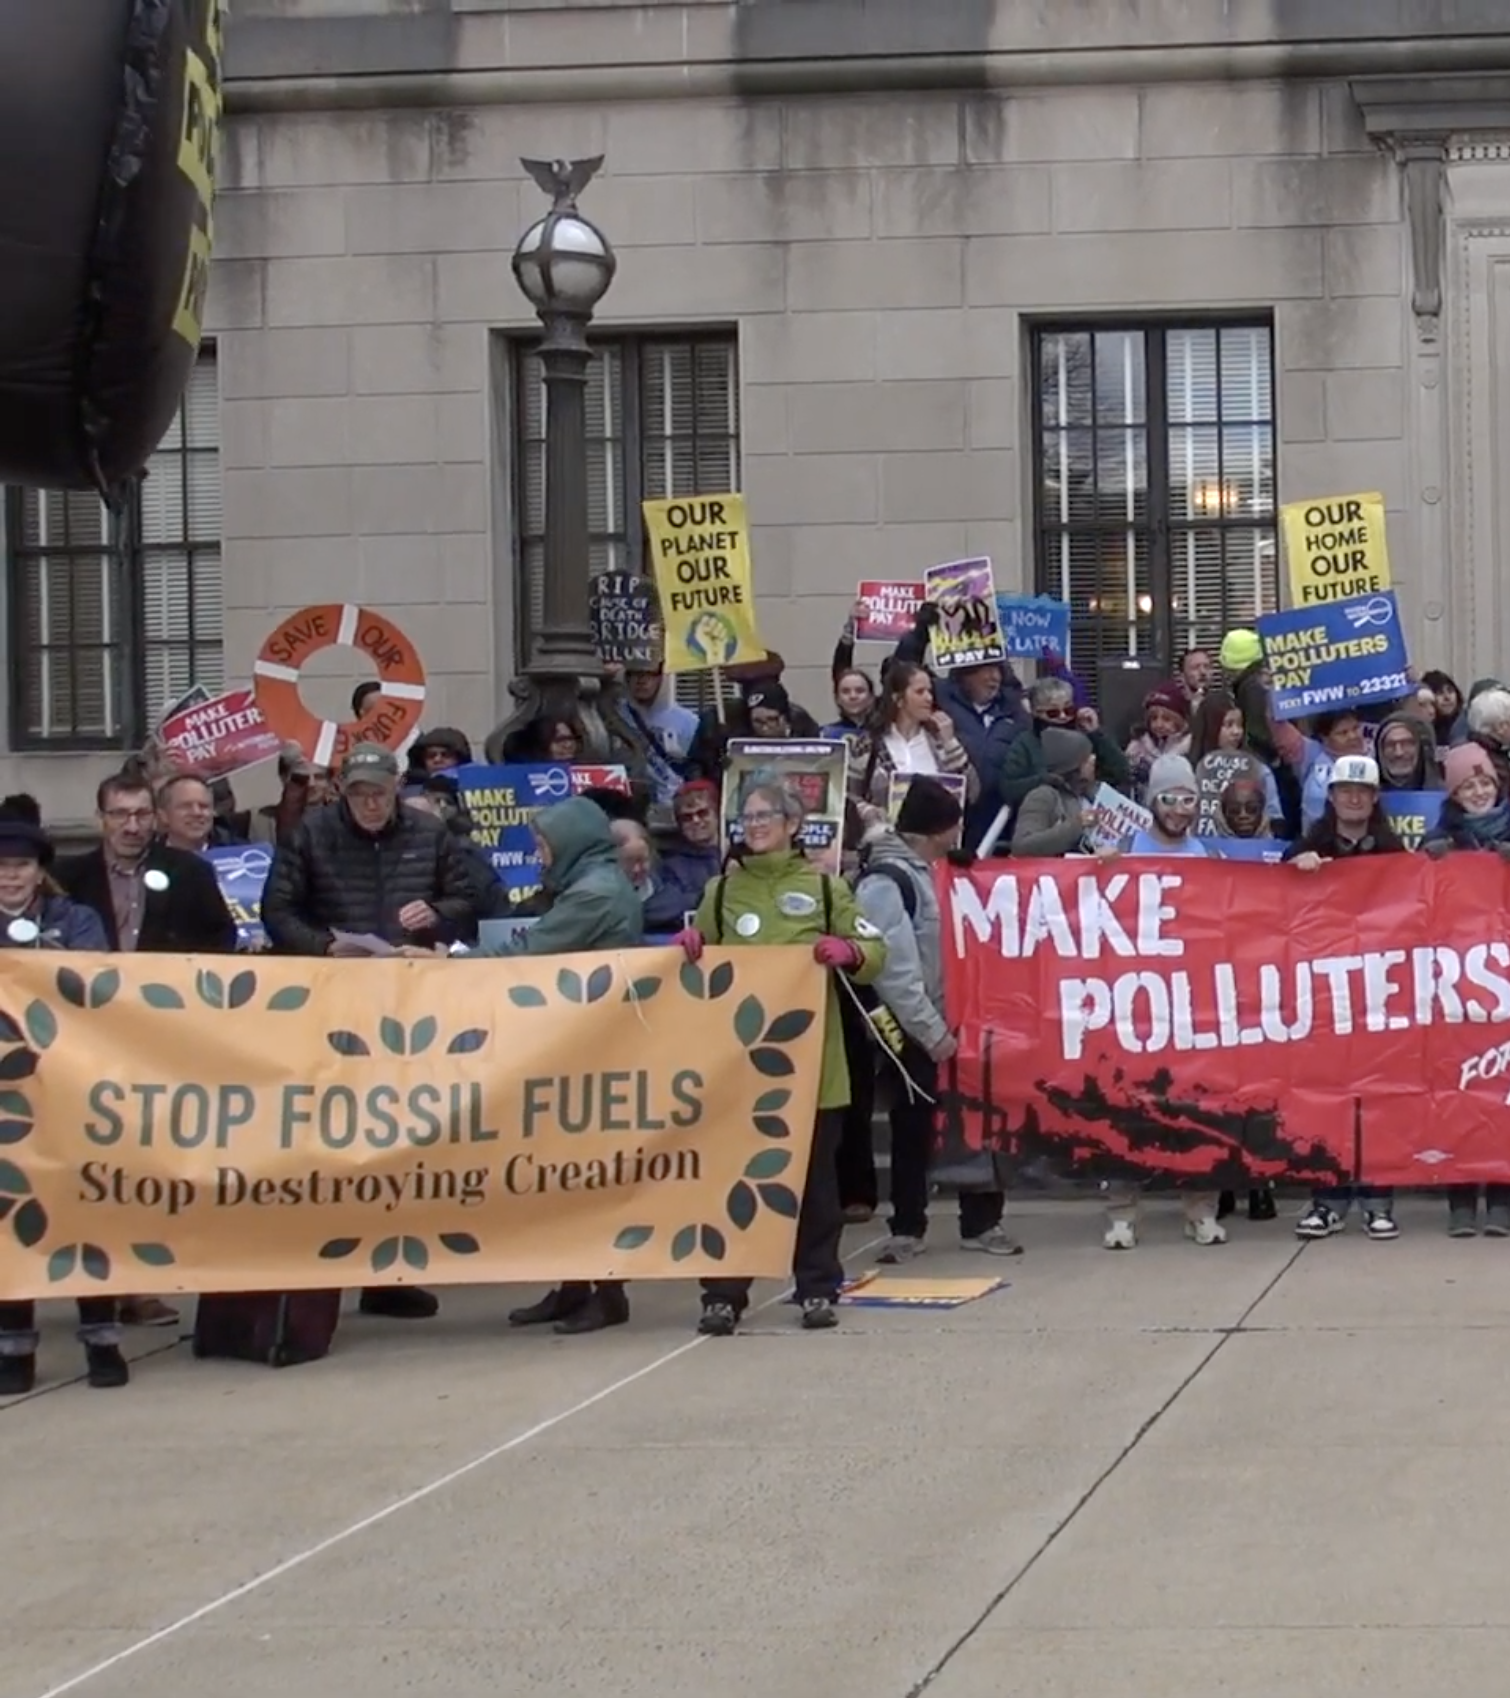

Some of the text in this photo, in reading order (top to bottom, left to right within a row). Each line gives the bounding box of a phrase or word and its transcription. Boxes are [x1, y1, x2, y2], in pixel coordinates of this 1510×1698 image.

[667, 501, 726, 528] OUR
[1304, 500, 1365, 528] OUR
[660, 531, 739, 558] PLANET
[1305, 526, 1368, 551] HOME
[676, 556, 731, 584] OUR
[1310, 549, 1369, 577] OUR
[598, 576, 640, 594] RIP
[881, 586, 915, 598] MAKE
[1302, 575, 1381, 603] FUTURE
[670, 585, 743, 611] FUTURE
[862, 596, 922, 615] POLLUT
[869, 611, 894, 625] PAY
[1011, 610, 1052, 628] NOW
[269, 616, 329, 662] SAVE
[361, 625, 405, 670] OUR
[590, 621, 660, 643] BRIDGE
[1015, 634, 1061, 652] LATER
[1265, 626, 1329, 655] MAKE
[595, 645, 652, 661] AILURE
[1268, 634, 1389, 672] POLLUTERS
[1272, 669, 1312, 691] PAY
[1302, 685, 1344, 707] FWW
[1347, 687, 1359, 697] TO
[1360, 672, 1407, 695] 23321
[185, 702, 230, 731] MAKE
[168, 707, 264, 750] POLLUTER
[186, 742, 217, 764] PAY
[1203, 755, 1250, 770] CAUSE
[571, 772, 593, 785] AKE
[1217, 769, 1233, 779] OF
[1202, 779, 1229, 793] DEA
[465, 788, 516, 808] MAKE
[471, 806, 543, 827] POLLUT
[1117, 802, 1152, 828] MAKE
[1387, 815, 1426, 835] KE
[470, 828, 501, 848] PAY
[492, 852, 525, 867] FWW
[950, 873, 1184, 959] MAKE
[83, 1069, 705, 1149] STOP FOSSIL FUELS
[78, 1146, 701, 1215] Stop Destroying Creation
